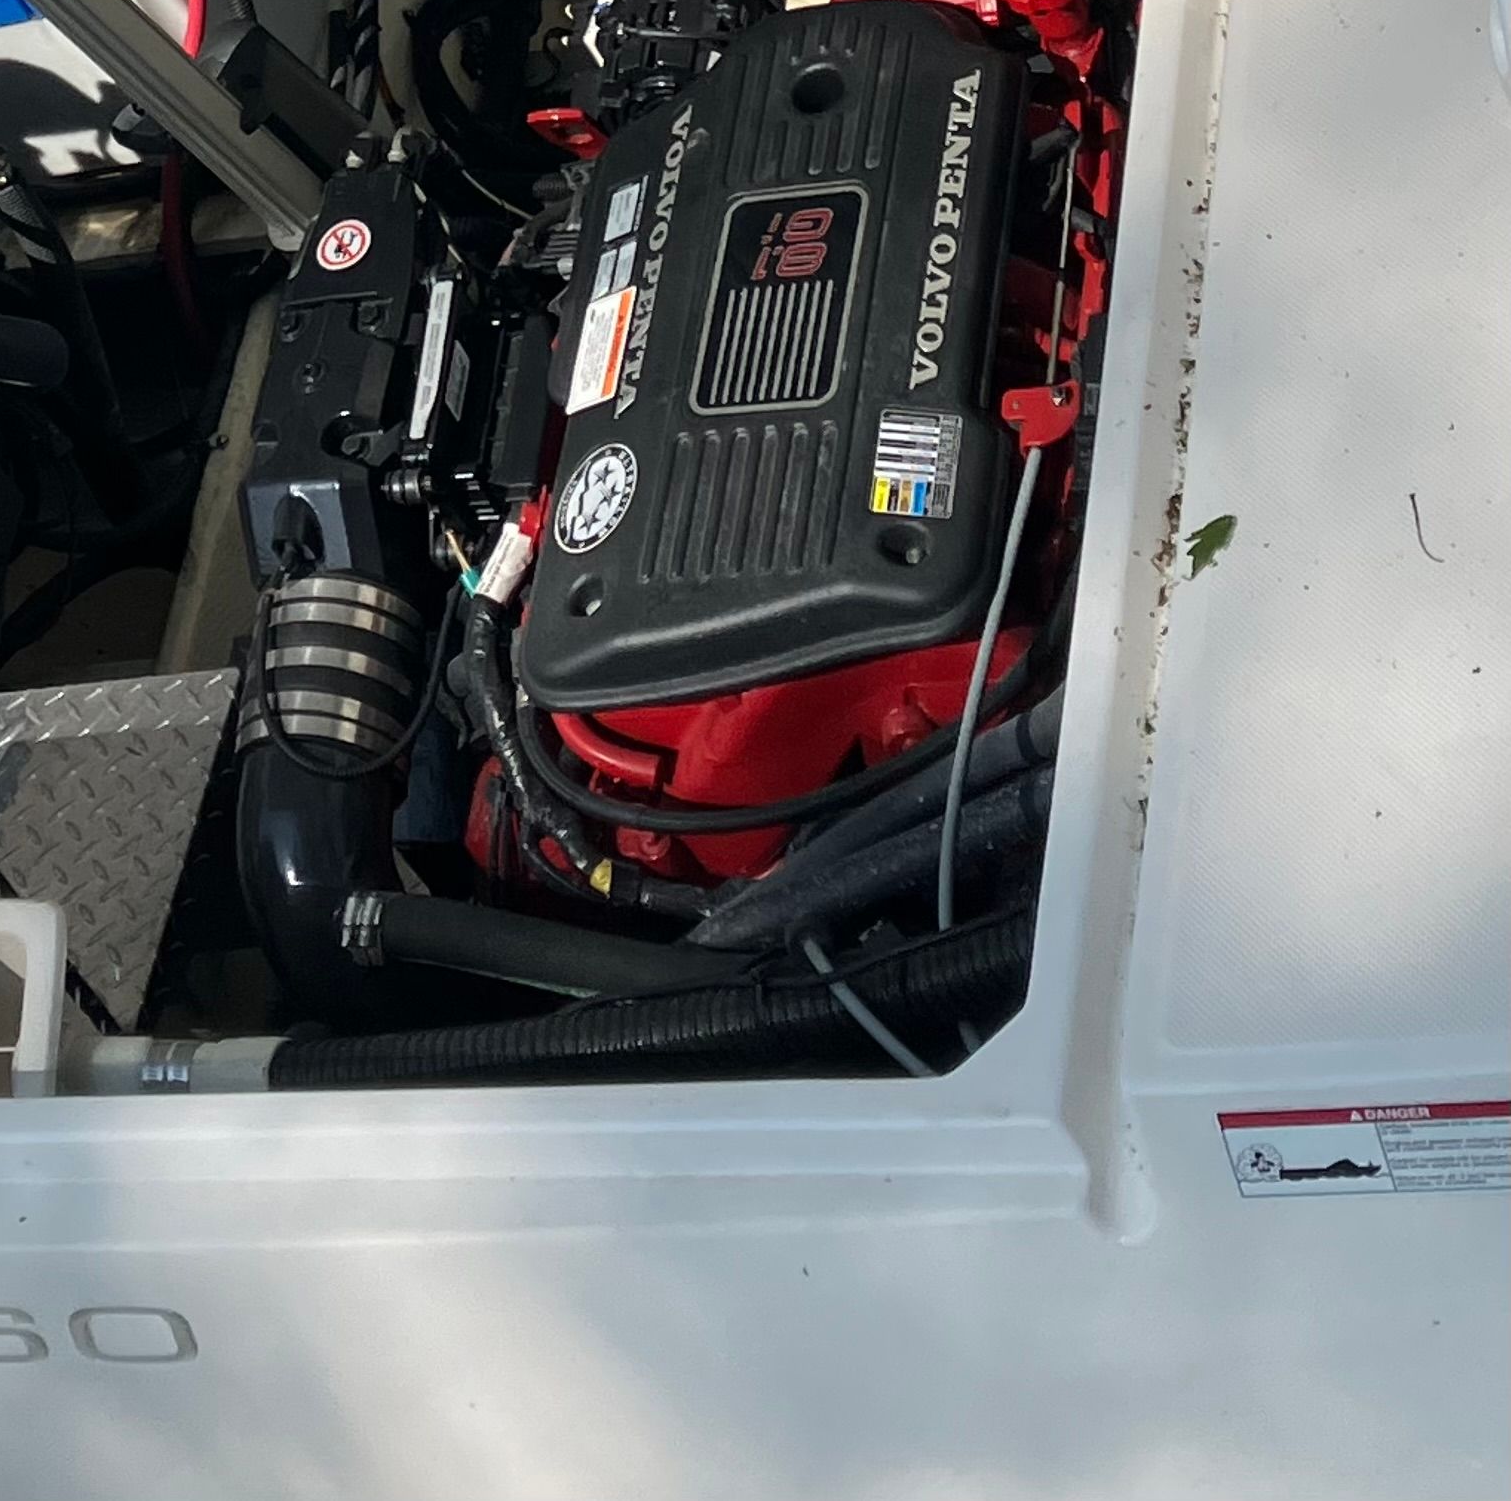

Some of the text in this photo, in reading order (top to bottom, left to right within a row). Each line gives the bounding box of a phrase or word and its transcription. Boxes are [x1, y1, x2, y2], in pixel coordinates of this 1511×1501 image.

[647, 104, 694, 251] VOLVO
[932, 69, 983, 231] PENTA
[613, 252, 663, 419] PENTA
[909, 234, 957, 390] VOLVO
[1364, 1106, 1432, 1121] DANGER
